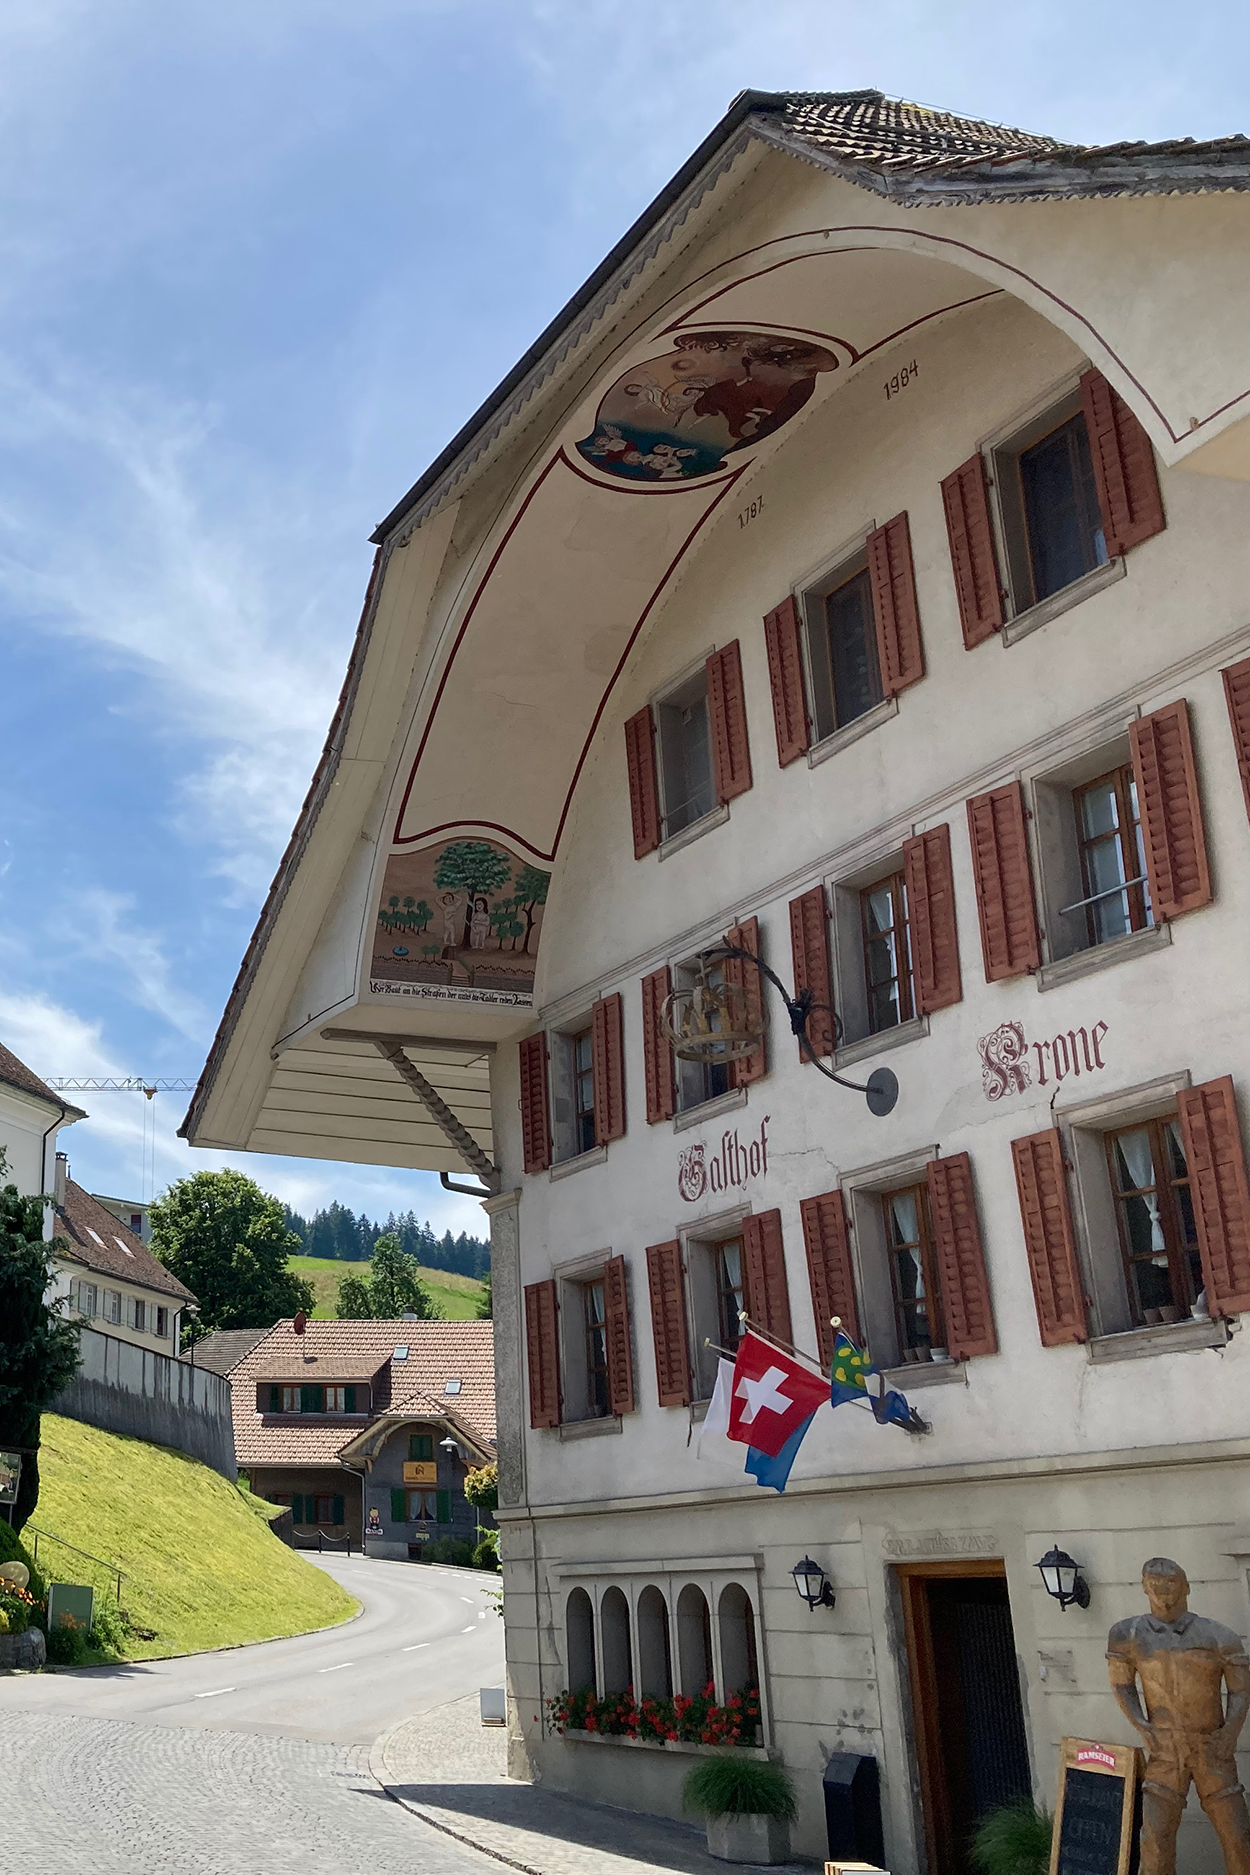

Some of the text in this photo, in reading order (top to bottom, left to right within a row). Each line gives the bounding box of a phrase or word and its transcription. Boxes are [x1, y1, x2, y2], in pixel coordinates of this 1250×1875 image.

[883, 359, 918, 400] 1984
[737, 495, 763, 529] 1787
[412, 985, 421, 996] die
[447, 989, 457, 999] der
[678, 1020, 1109, 1202] Gasthof Krone
[1078, 1751, 1115, 1767] RAMSEIER
